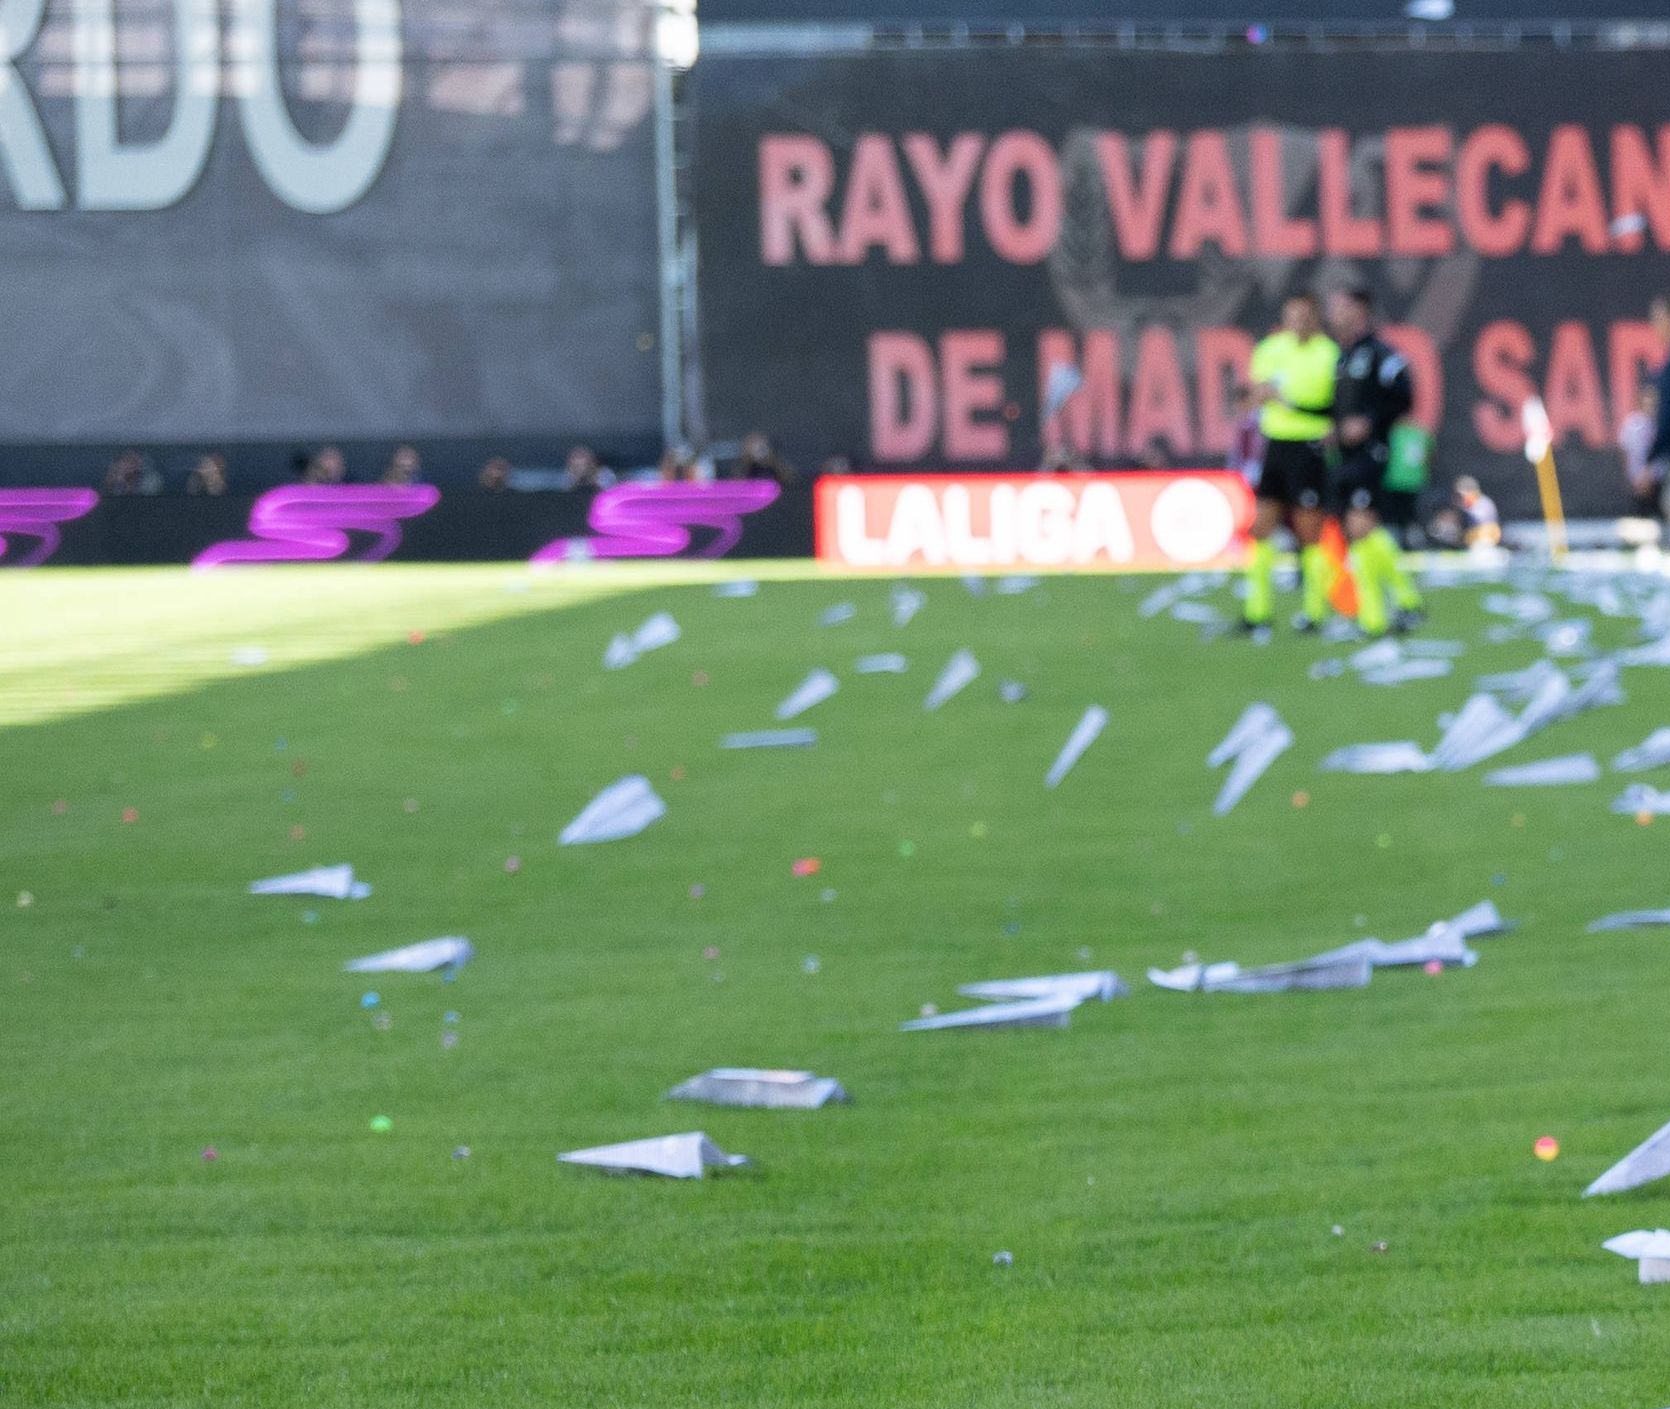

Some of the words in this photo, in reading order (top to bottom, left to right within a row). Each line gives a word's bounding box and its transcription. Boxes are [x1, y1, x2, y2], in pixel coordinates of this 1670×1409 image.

[759, 132, 1063, 266] RAYO
[867, 332, 1010, 461] DE
[1038, 323, 1442, 458] MADD
[837, 480, 1136, 565] LALIGA
